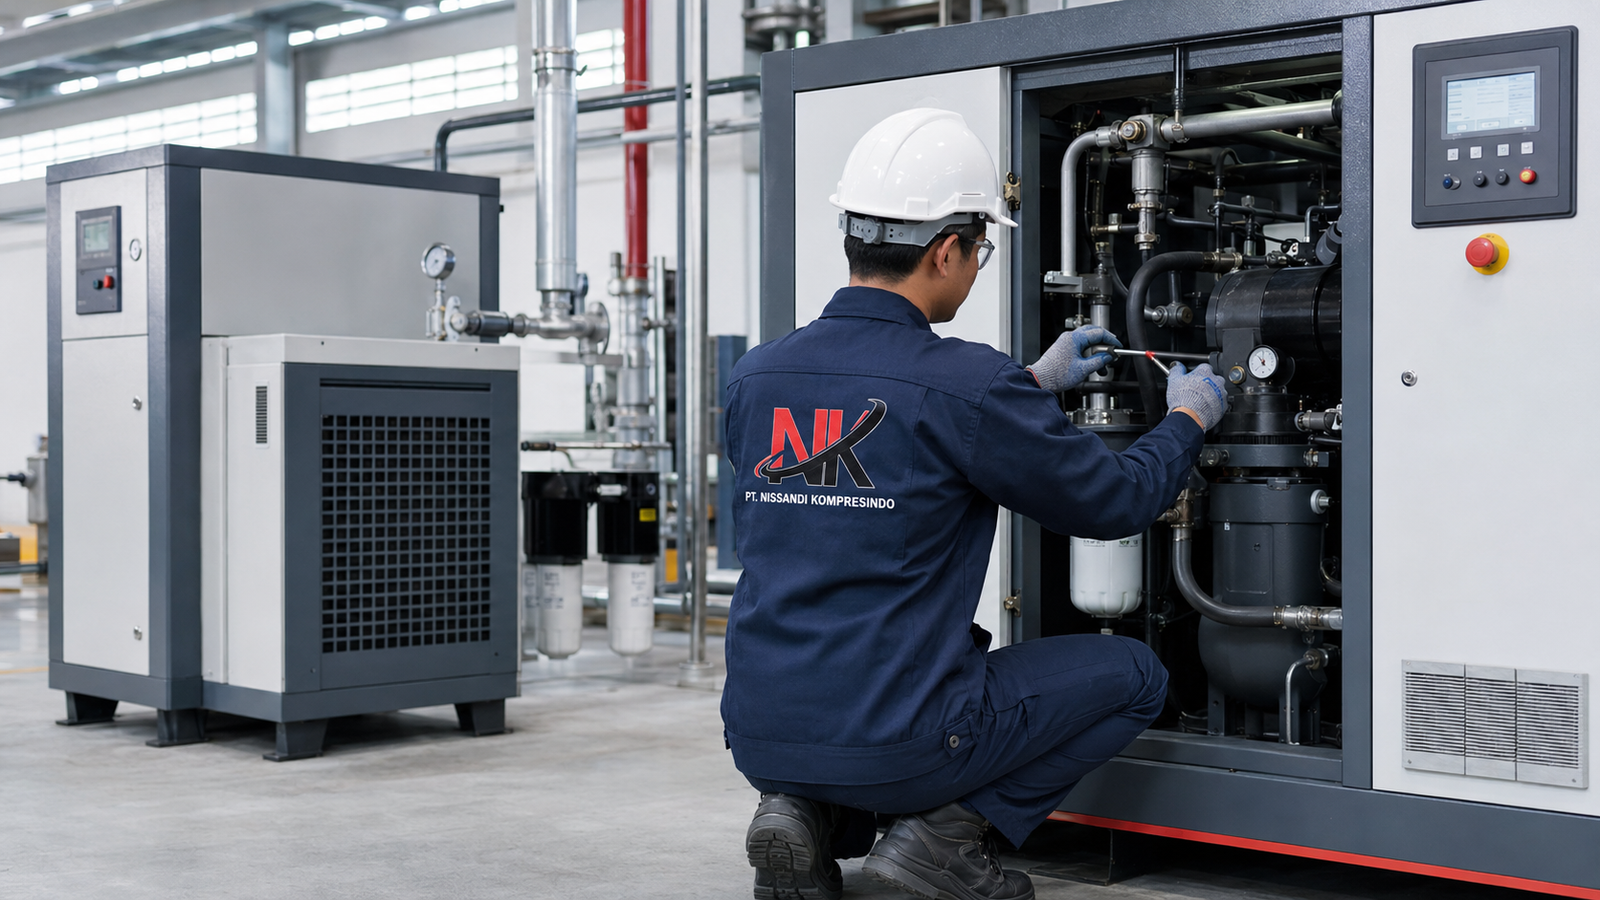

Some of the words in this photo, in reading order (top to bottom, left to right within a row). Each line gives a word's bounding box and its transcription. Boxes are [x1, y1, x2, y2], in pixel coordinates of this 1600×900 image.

[745, 491, 758, 502] PT.
[760, 492, 808, 505] NISSANDI
[811, 494, 895, 510] KOMPRESINDO
